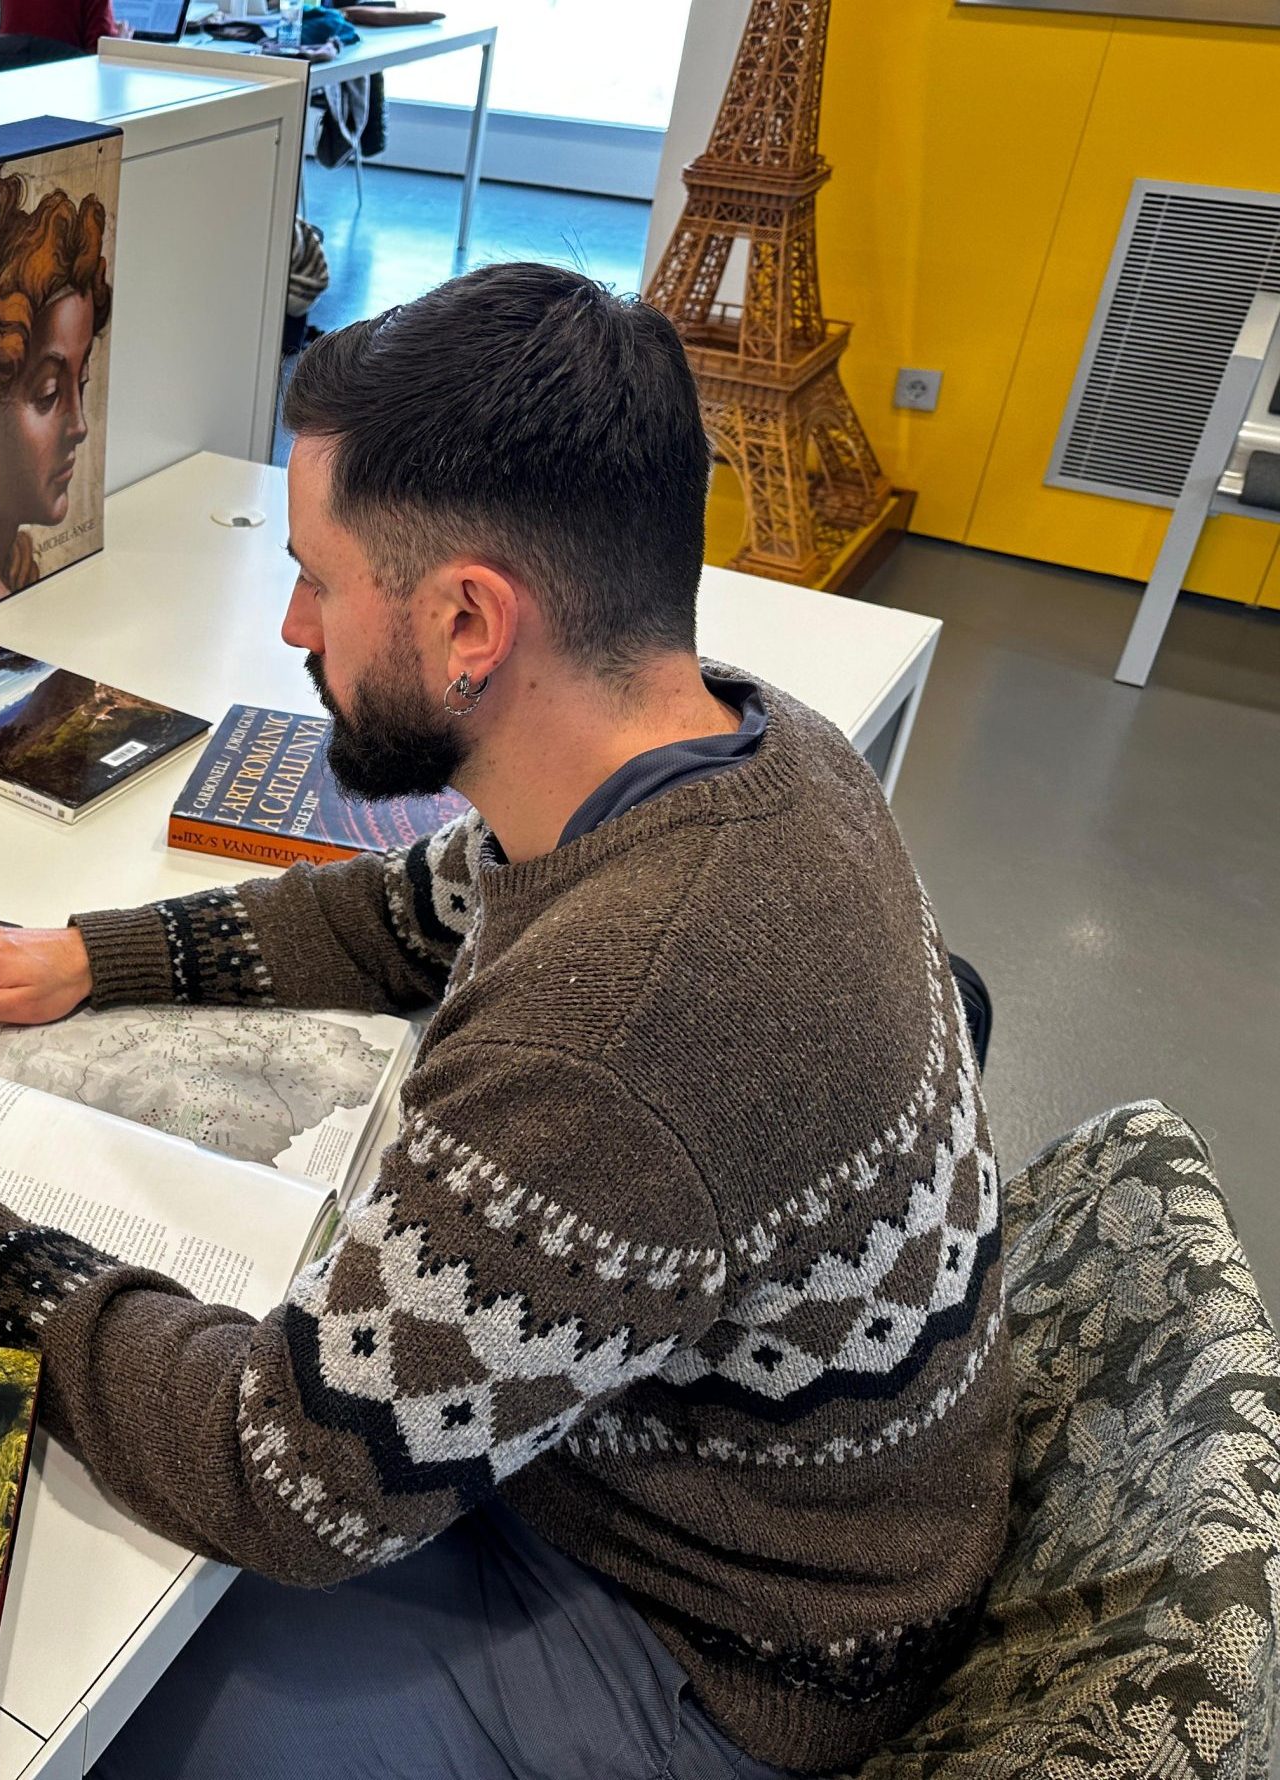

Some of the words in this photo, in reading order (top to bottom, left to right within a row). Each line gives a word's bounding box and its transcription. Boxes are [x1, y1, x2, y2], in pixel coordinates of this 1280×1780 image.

[193, 761, 231, 809] CARBONELL
[225, 726, 248, 754] JORDI
[235, 713, 293, 782] ROMÀNIC
[259, 720, 328, 814] CATALUNYA
[214, 780, 257, 825] L'ART
[251, 818, 283, 832] A
